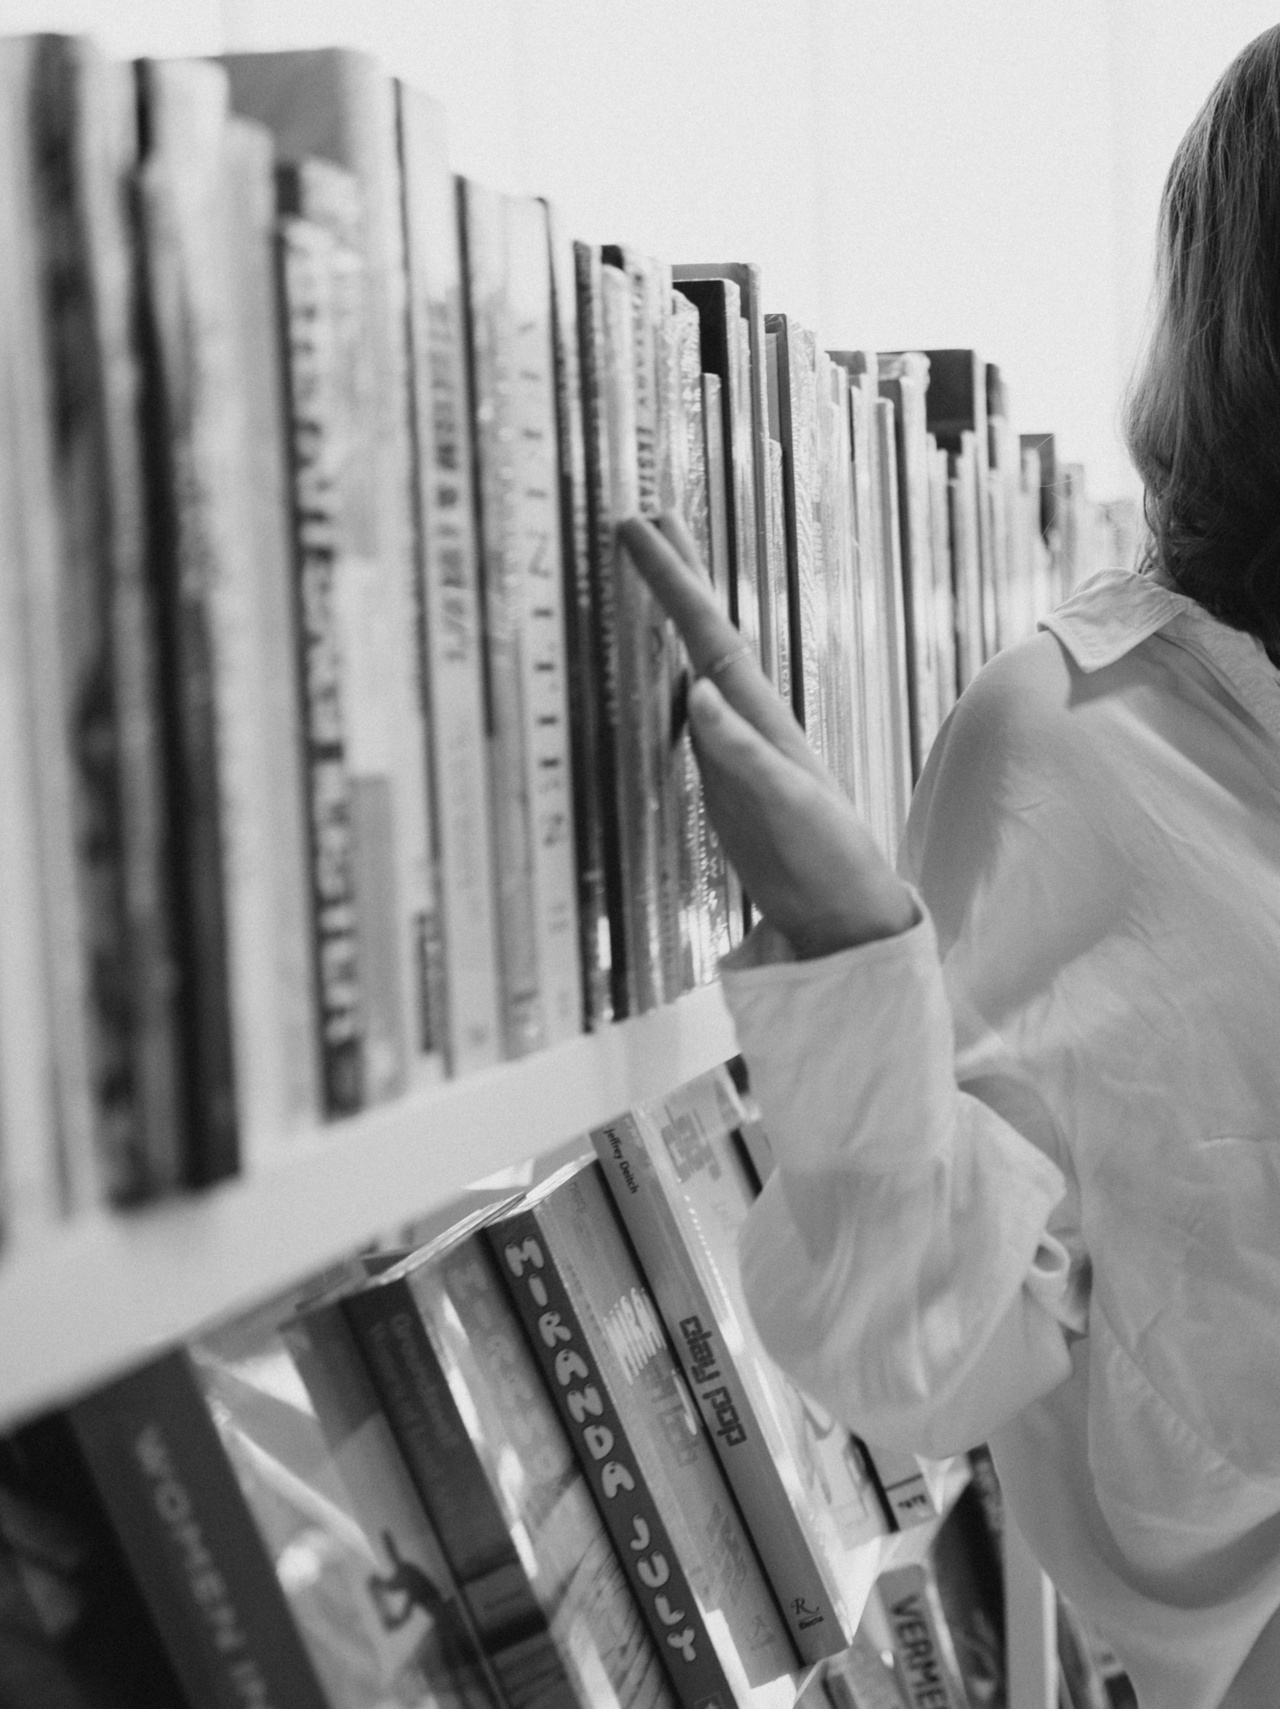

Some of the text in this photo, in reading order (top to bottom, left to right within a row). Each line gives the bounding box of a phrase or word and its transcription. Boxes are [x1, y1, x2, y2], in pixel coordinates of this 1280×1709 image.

[603, 1128, 640, 1195] Jeffrey Deitch
[504, 1236, 636, 1499] MIRANDA
[629, 1512, 697, 1662] JULY
[702, 1386, 747, 1447] pop
